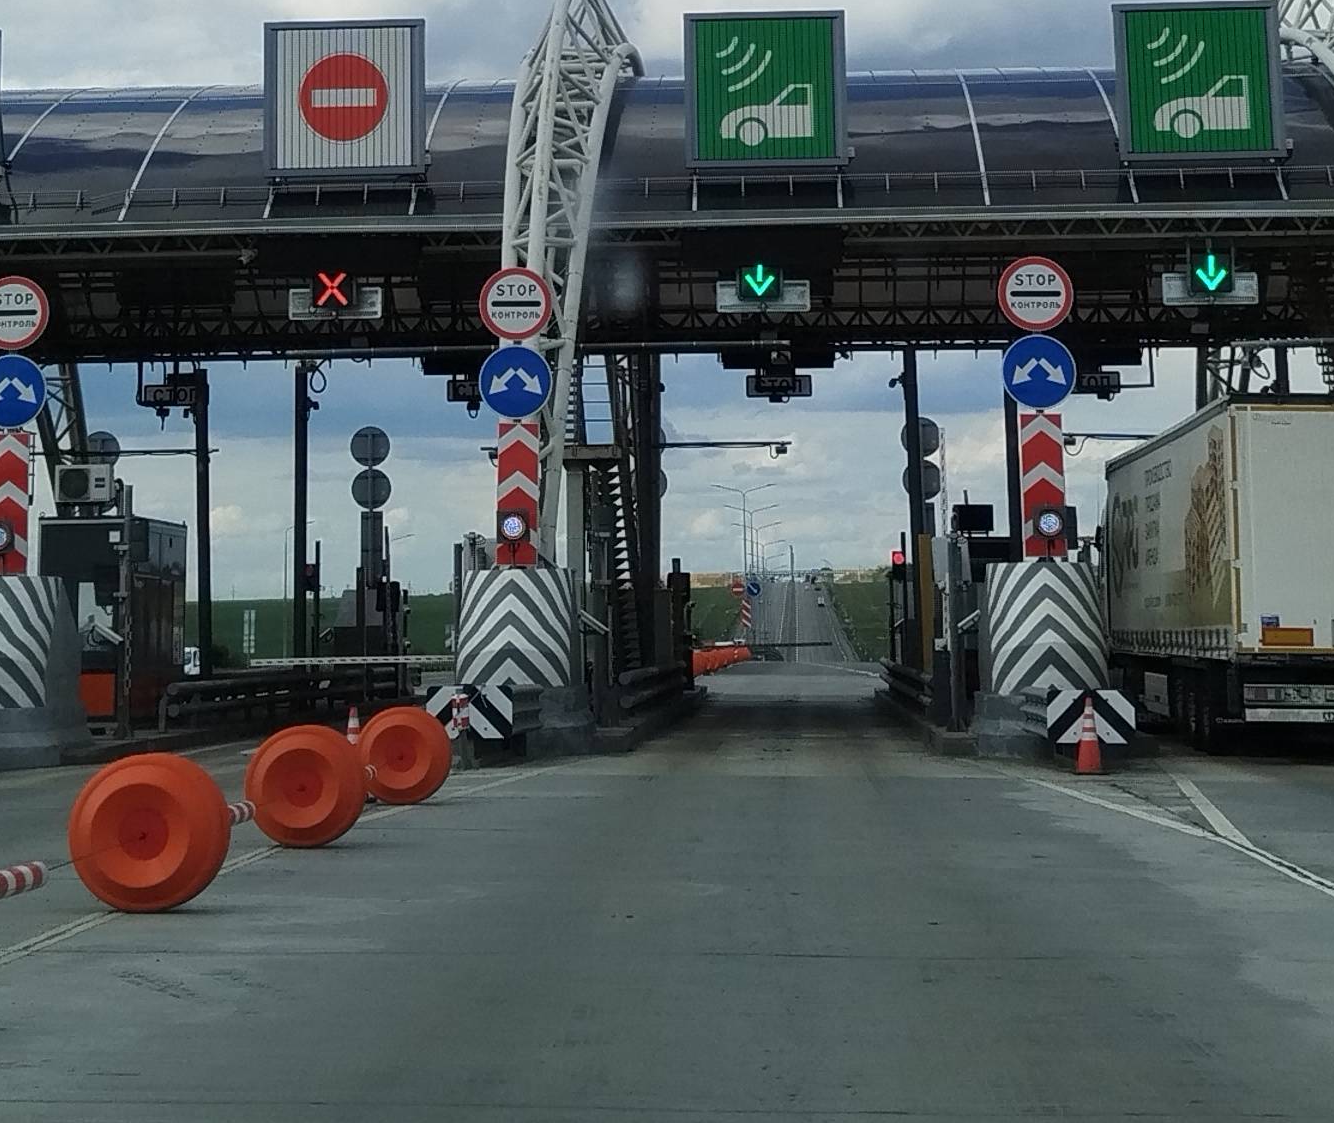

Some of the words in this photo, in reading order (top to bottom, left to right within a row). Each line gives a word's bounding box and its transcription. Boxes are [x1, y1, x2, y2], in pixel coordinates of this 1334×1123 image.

[1014, 274, 1056, 286] STOP
[496, 284, 537, 296] STOP
[1010, 301, 1061, 309] КОНТРОЛЬ
[491, 311, 540, 319] КОНТРОЛЬ
